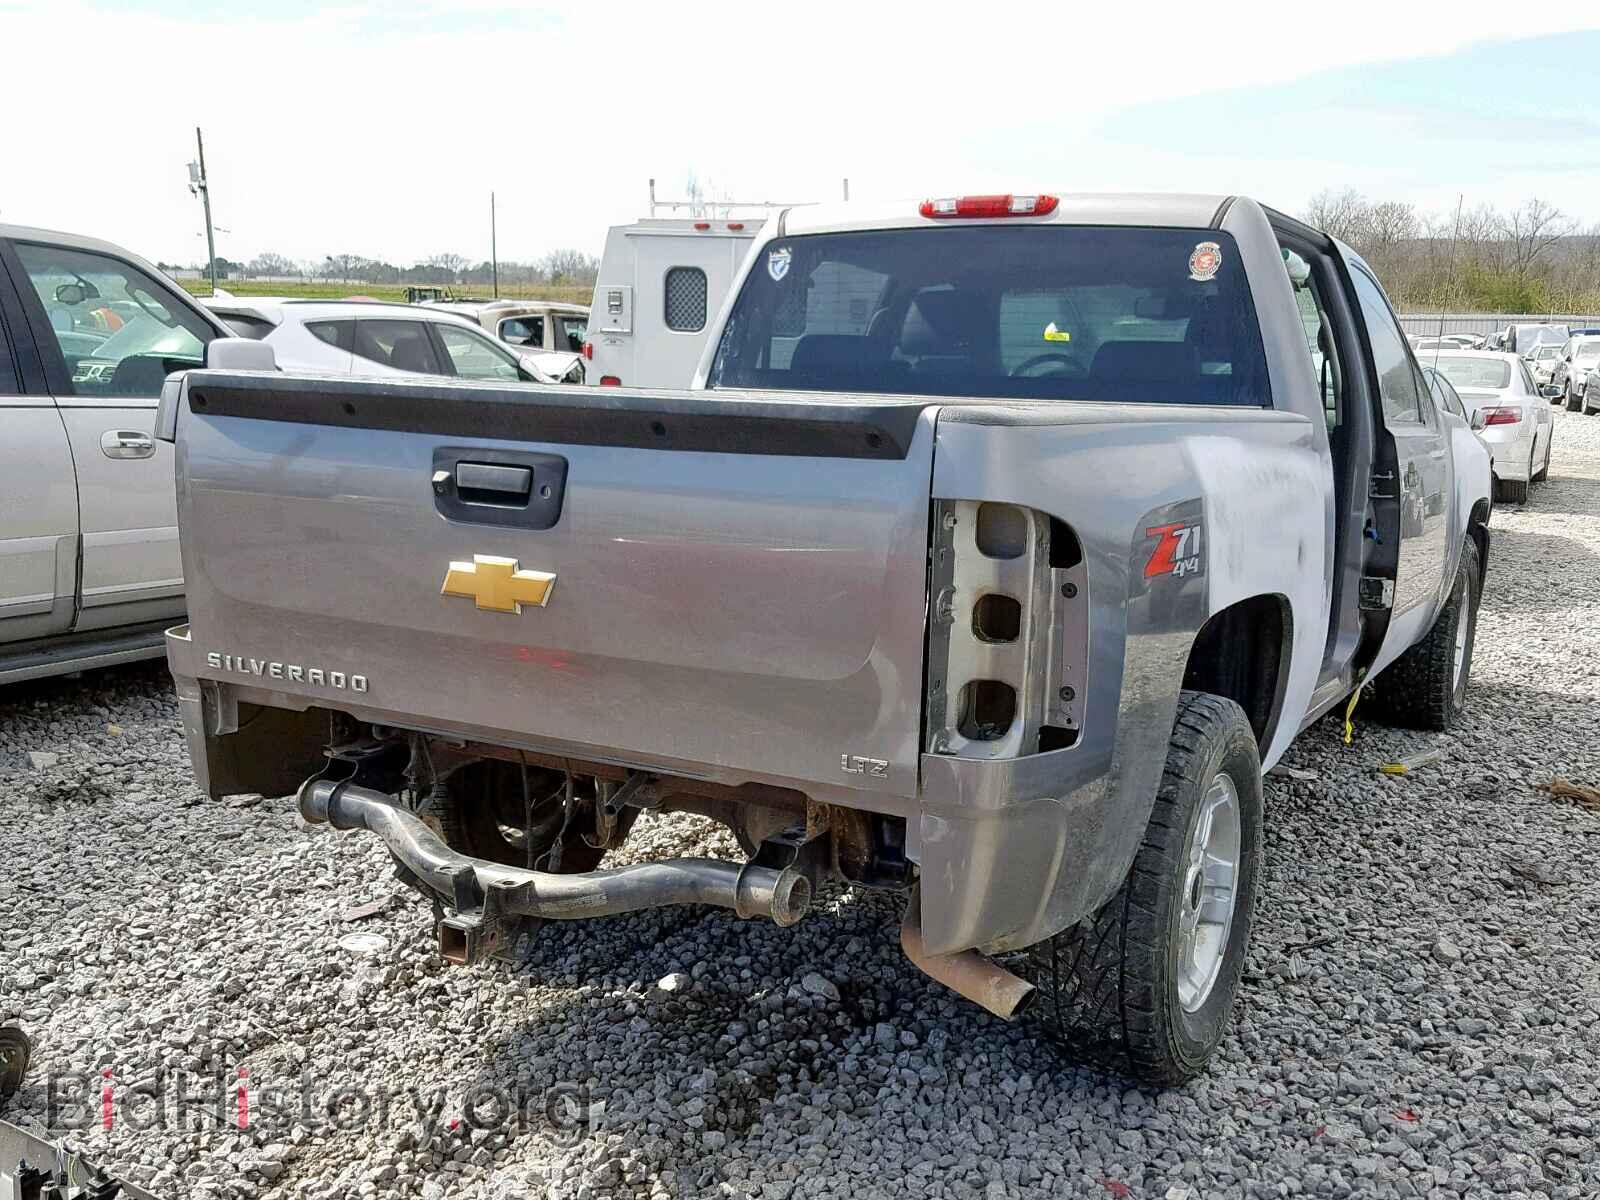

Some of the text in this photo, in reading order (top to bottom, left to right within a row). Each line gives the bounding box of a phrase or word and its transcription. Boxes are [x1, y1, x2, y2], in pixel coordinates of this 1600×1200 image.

[1144, 523, 1200, 577] Z71
[207, 652, 369, 692] SILVERADO
[841, 754, 888, 778] LTZ
